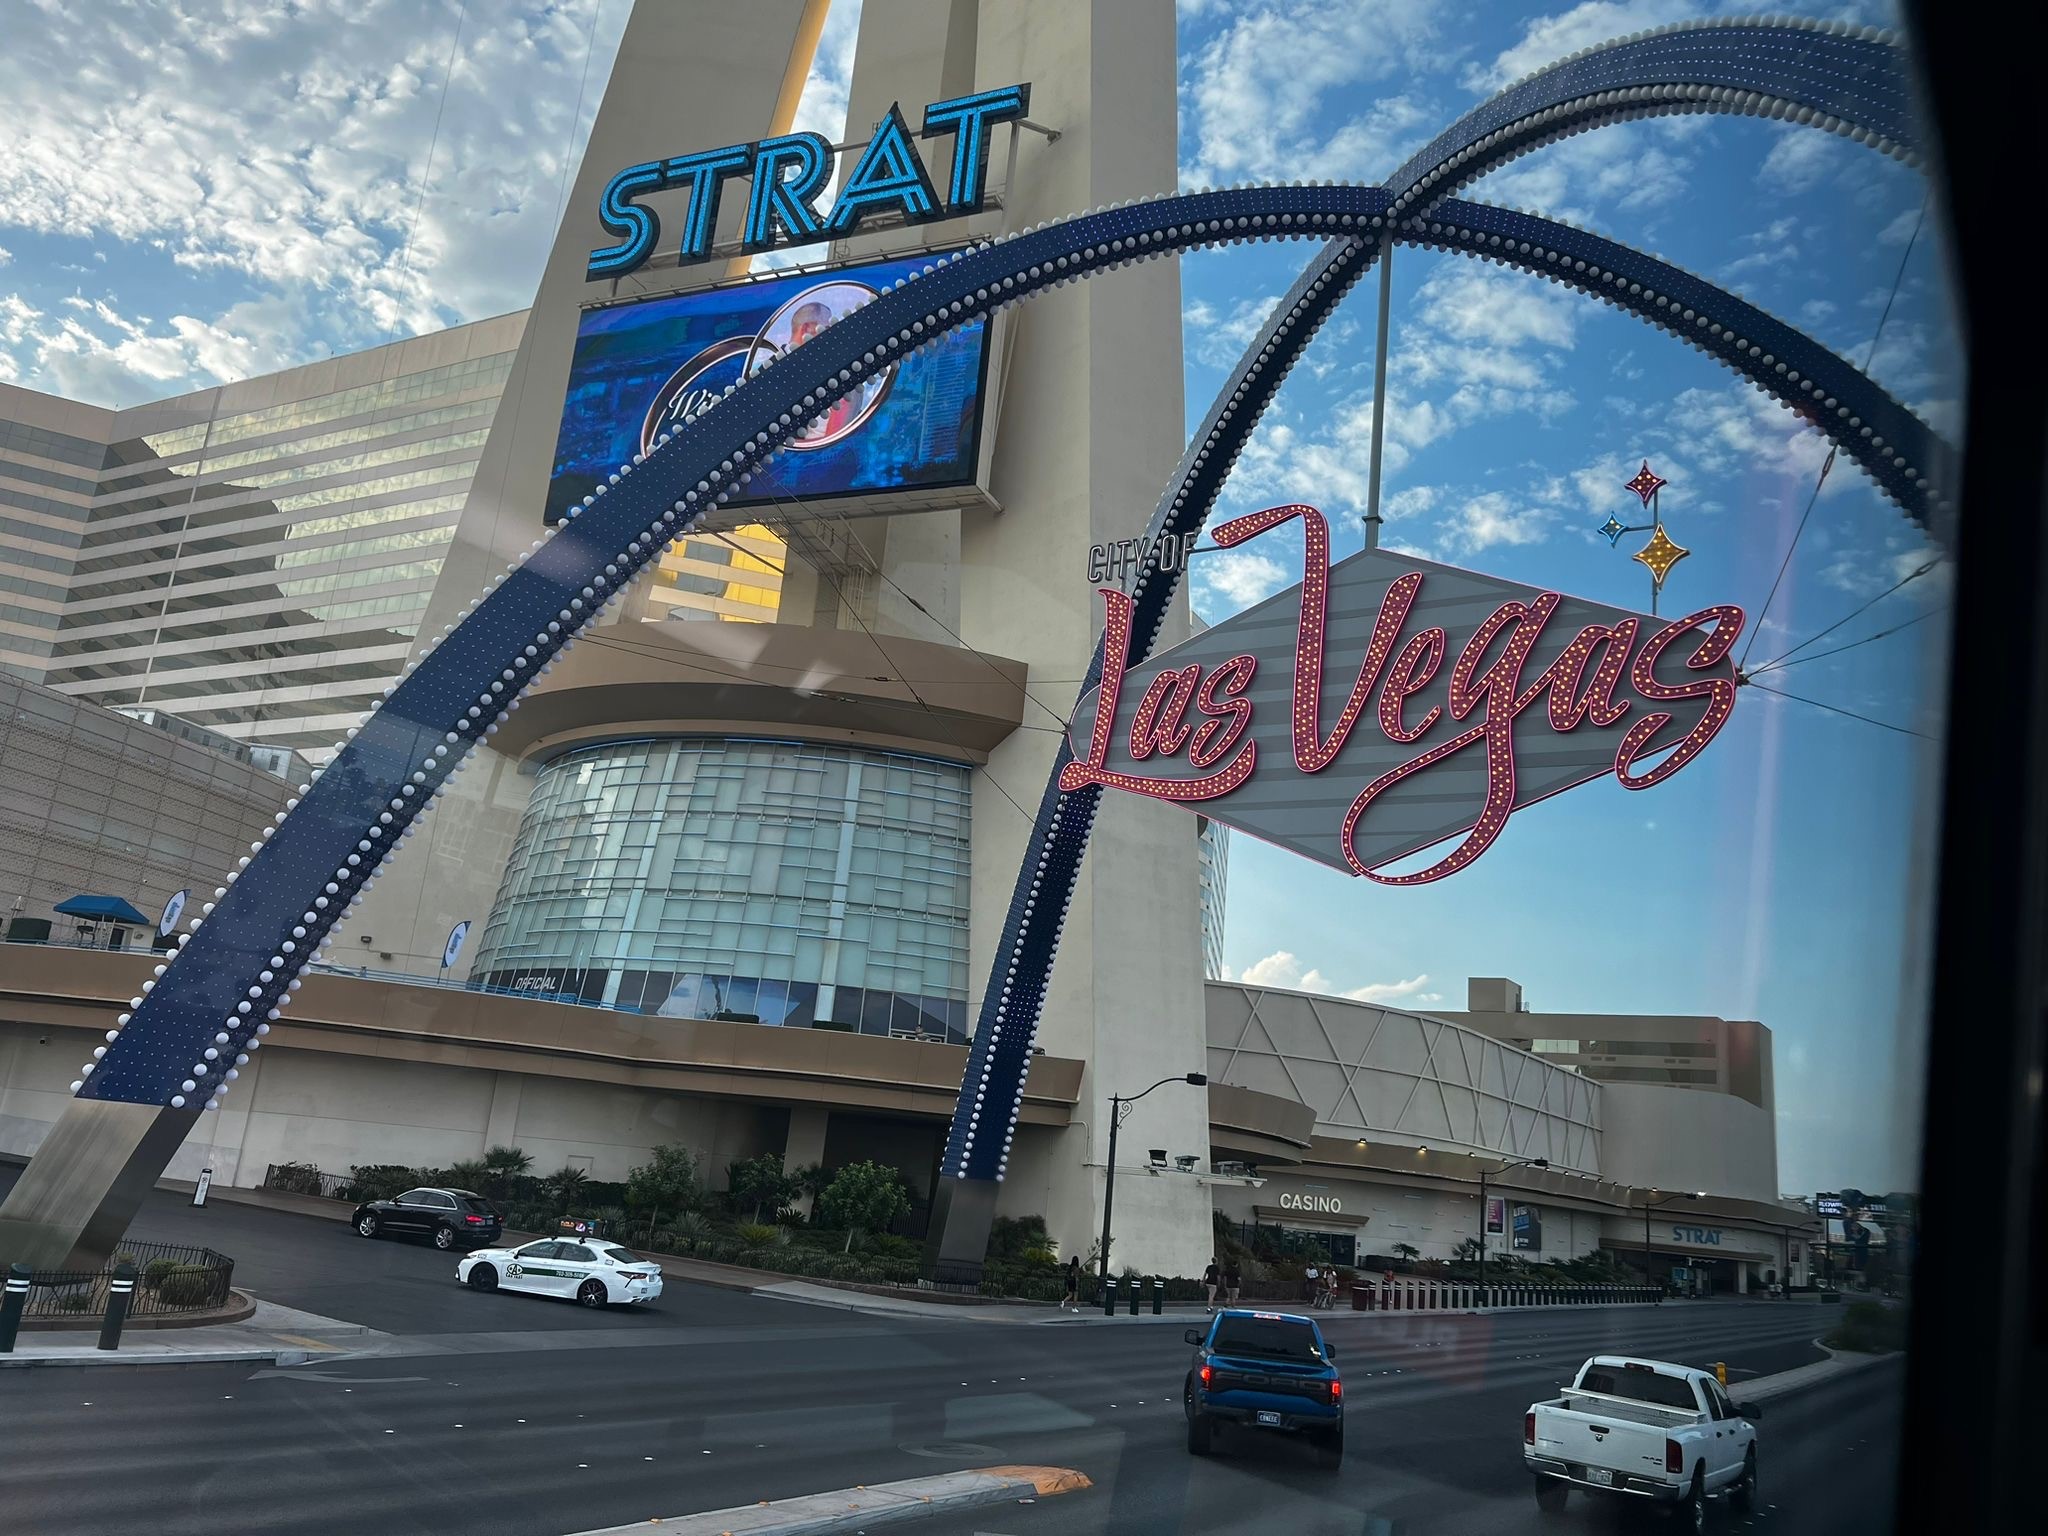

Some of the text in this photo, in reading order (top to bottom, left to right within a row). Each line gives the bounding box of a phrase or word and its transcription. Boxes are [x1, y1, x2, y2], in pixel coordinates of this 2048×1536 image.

[586, 83, 1030, 282] STRAT
[1088, 531, 1196, 583] CITY OF
[1058, 503, 1746, 886] Las Vegas
[514, 976, 557, 990] OFFICIAL
[1279, 1193, 1341, 1214] CASINO
[1672, 1225, 1722, 1245] STRAT
